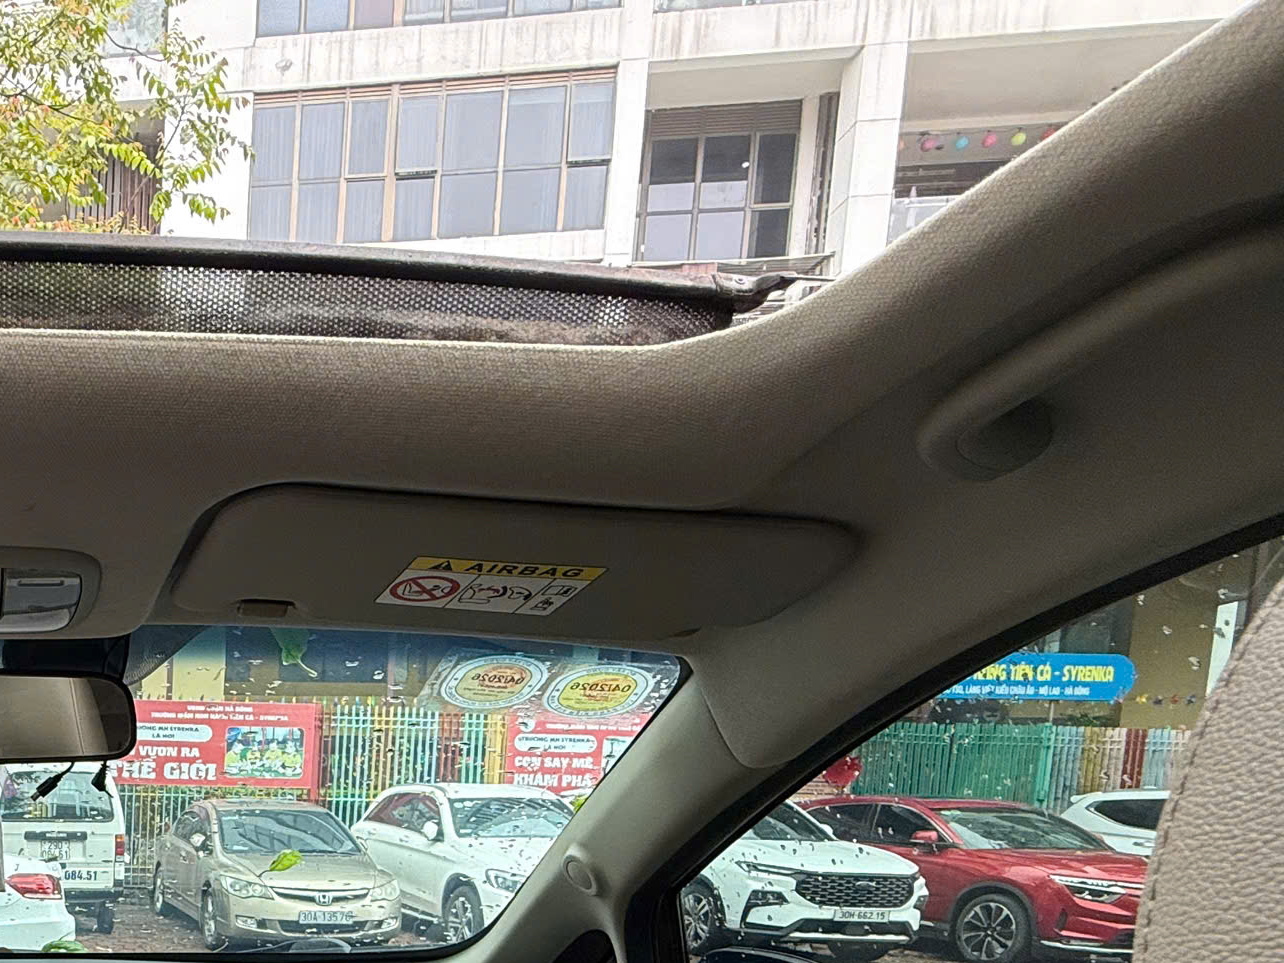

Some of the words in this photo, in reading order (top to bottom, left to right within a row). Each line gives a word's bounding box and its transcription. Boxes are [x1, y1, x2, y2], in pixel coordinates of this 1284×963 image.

[464, 561, 584, 578] AIRBAG
[1036, 661, 1052, 682] CÁ
[1062, 665, 1115, 682] SYRENKA
[180, 746, 201, 758] RA
[544, 756, 571, 768] SAY
[64, 870, 98, 881] 084.51
